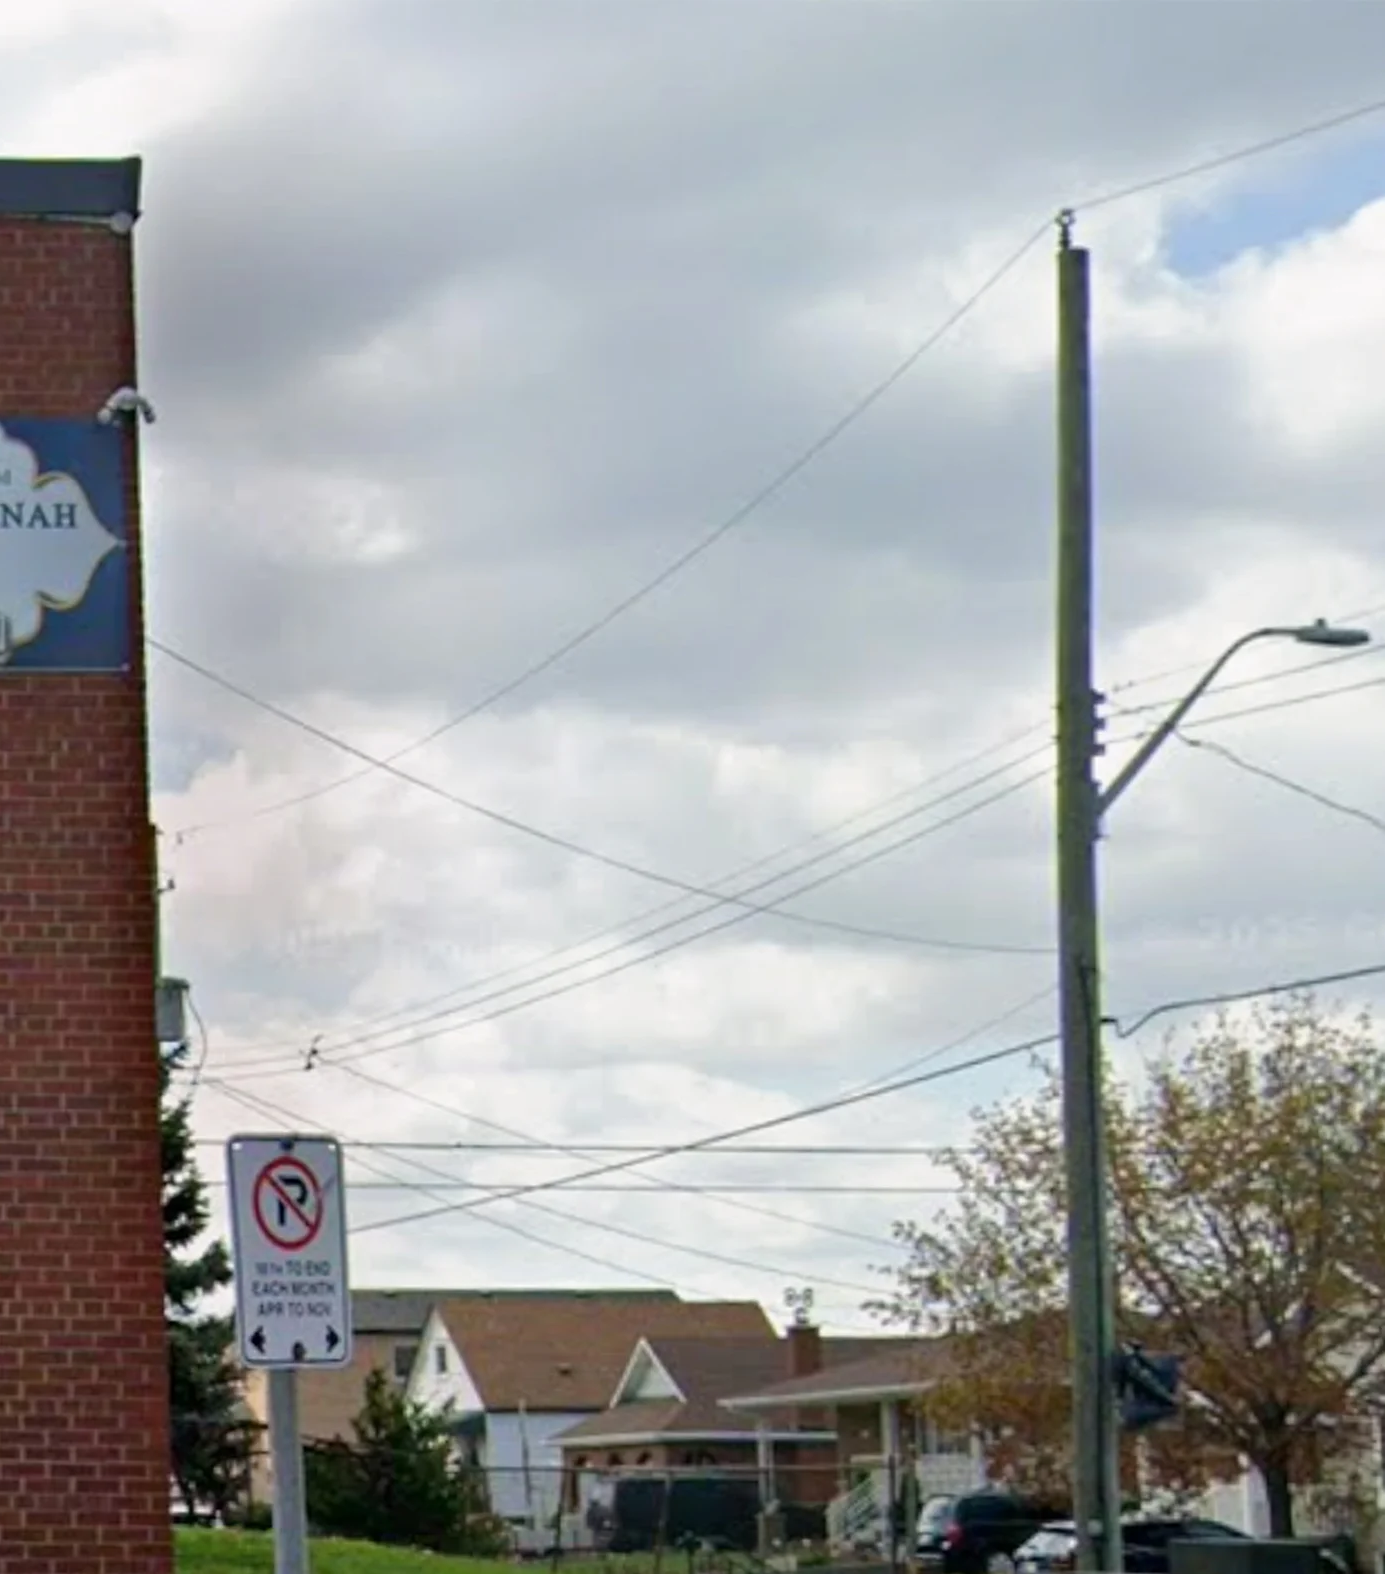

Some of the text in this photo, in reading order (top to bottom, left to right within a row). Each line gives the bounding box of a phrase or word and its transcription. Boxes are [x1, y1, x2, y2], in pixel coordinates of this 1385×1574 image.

[251, 1280, 336, 1297] EACH MONTH
[257, 1301, 284, 1317] APR
[287, 1301, 304, 1318] TO
